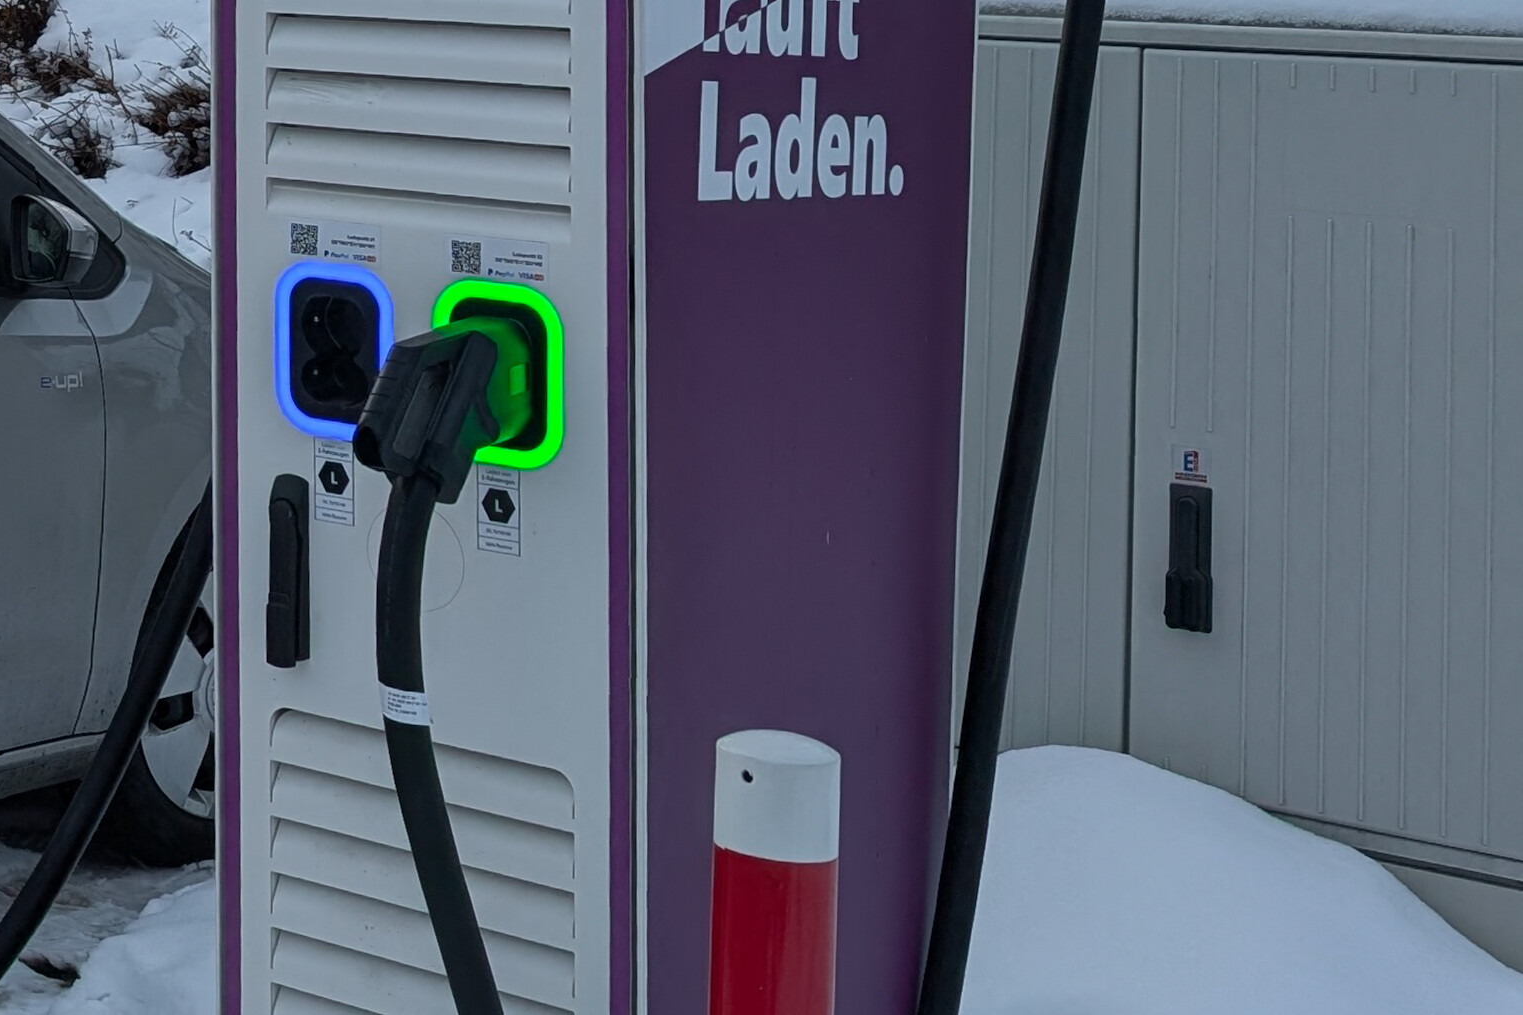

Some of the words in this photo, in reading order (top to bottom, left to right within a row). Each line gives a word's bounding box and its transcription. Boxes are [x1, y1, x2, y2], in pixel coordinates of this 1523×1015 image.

[696, 76, 905, 202] Laden.
[330, 471, 338, 485] L
[495, 497, 504, 513] L
